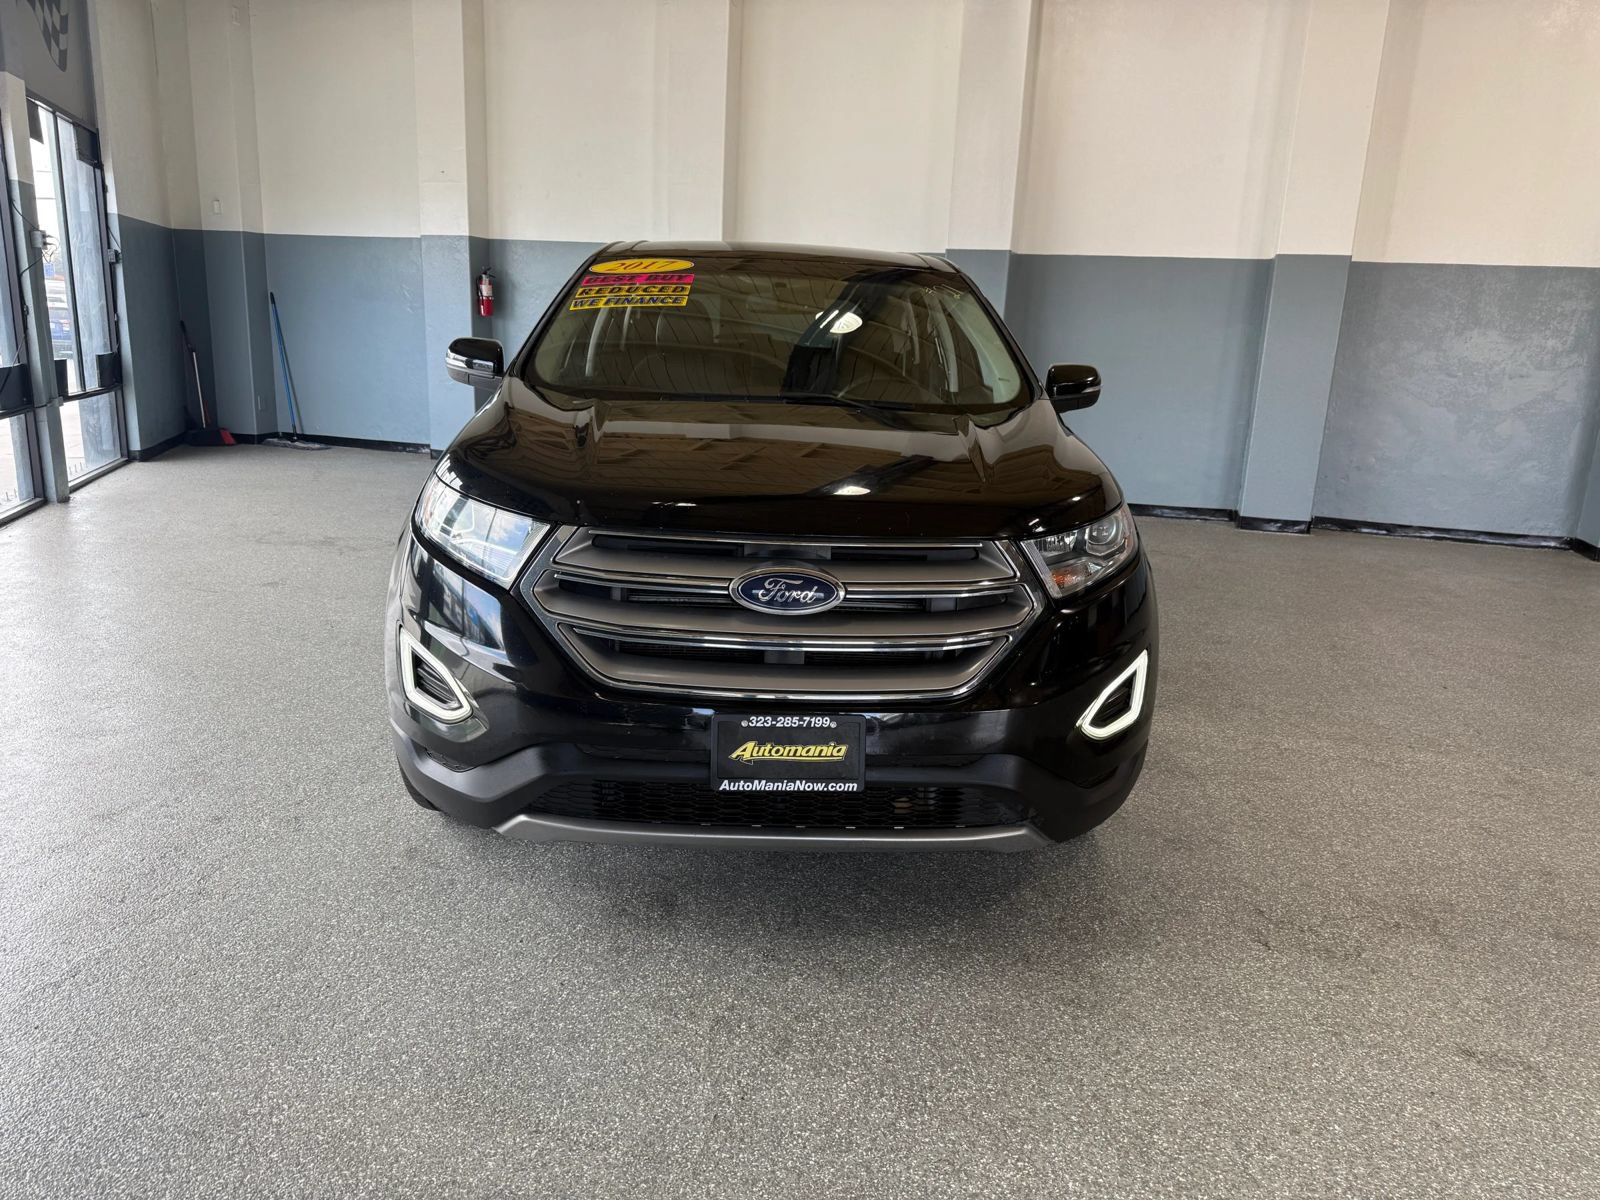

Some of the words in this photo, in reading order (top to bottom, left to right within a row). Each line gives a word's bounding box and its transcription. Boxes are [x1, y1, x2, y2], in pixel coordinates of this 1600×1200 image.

[606, 260, 676, 272] 2017
[578, 286, 687, 296] REDUCED
[573, 299, 600, 308] WE
[604, 296, 684, 306] FINANCE
[758, 577, 818, 603] Ford
[748, 716, 830, 728] 323-285-7199
[728, 740, 848, 762] Automania
[719, 779, 858, 792] AutoManiaNow.com
